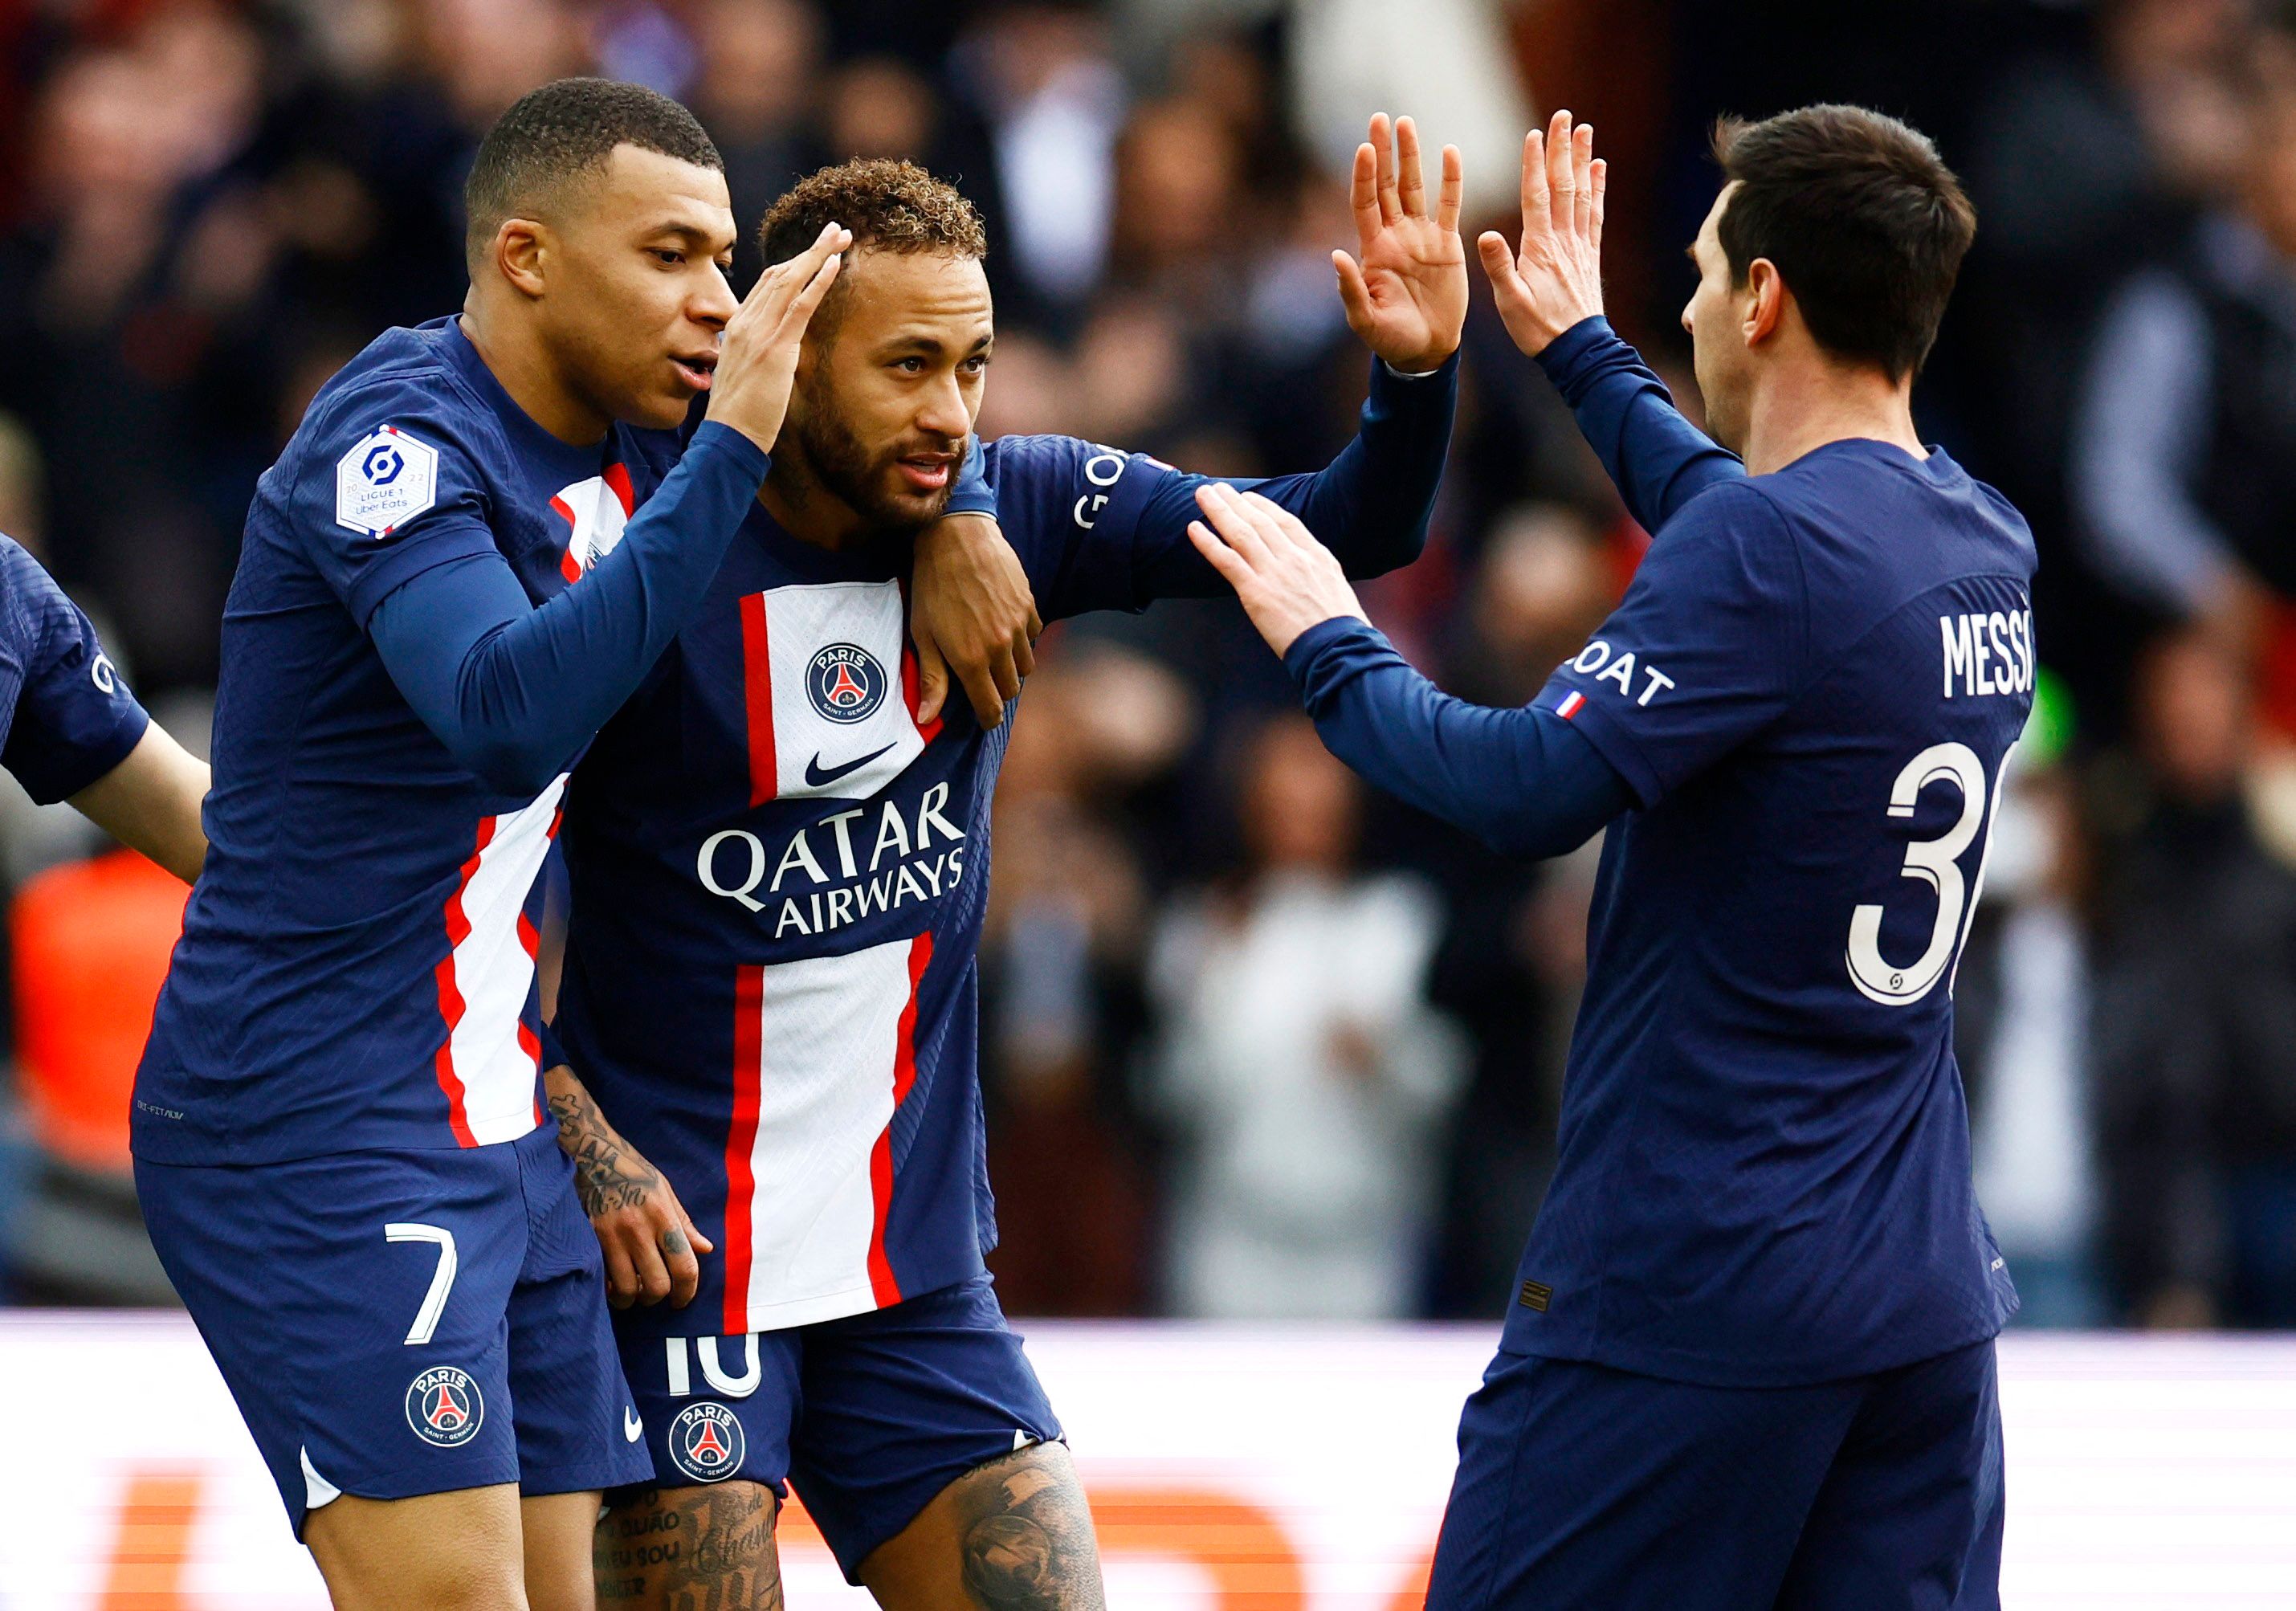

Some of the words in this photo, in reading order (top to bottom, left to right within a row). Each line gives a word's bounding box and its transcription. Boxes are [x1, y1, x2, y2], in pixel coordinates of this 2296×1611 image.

[346, 483, 358, 494] 20
[356, 503, 379, 515] Uber
[382, 499, 408, 509] Eats
[361, 489, 394, 502] LIGUE
[1074, 444, 1130, 529] GO
[816, 649, 867, 670] PARIS
[1564, 640, 1675, 707] OAT
[1939, 610, 2033, 698] MESSI
[697, 781, 966, 912] QATAR
[1845, 740, 2018, 1005] 3
[774, 846, 964, 938] AIRWAYS
[384, 1222, 458, 1345] 7
[415, 1370, 467, 1393] PARIS
[682, 1406, 733, 1427] PARIS
